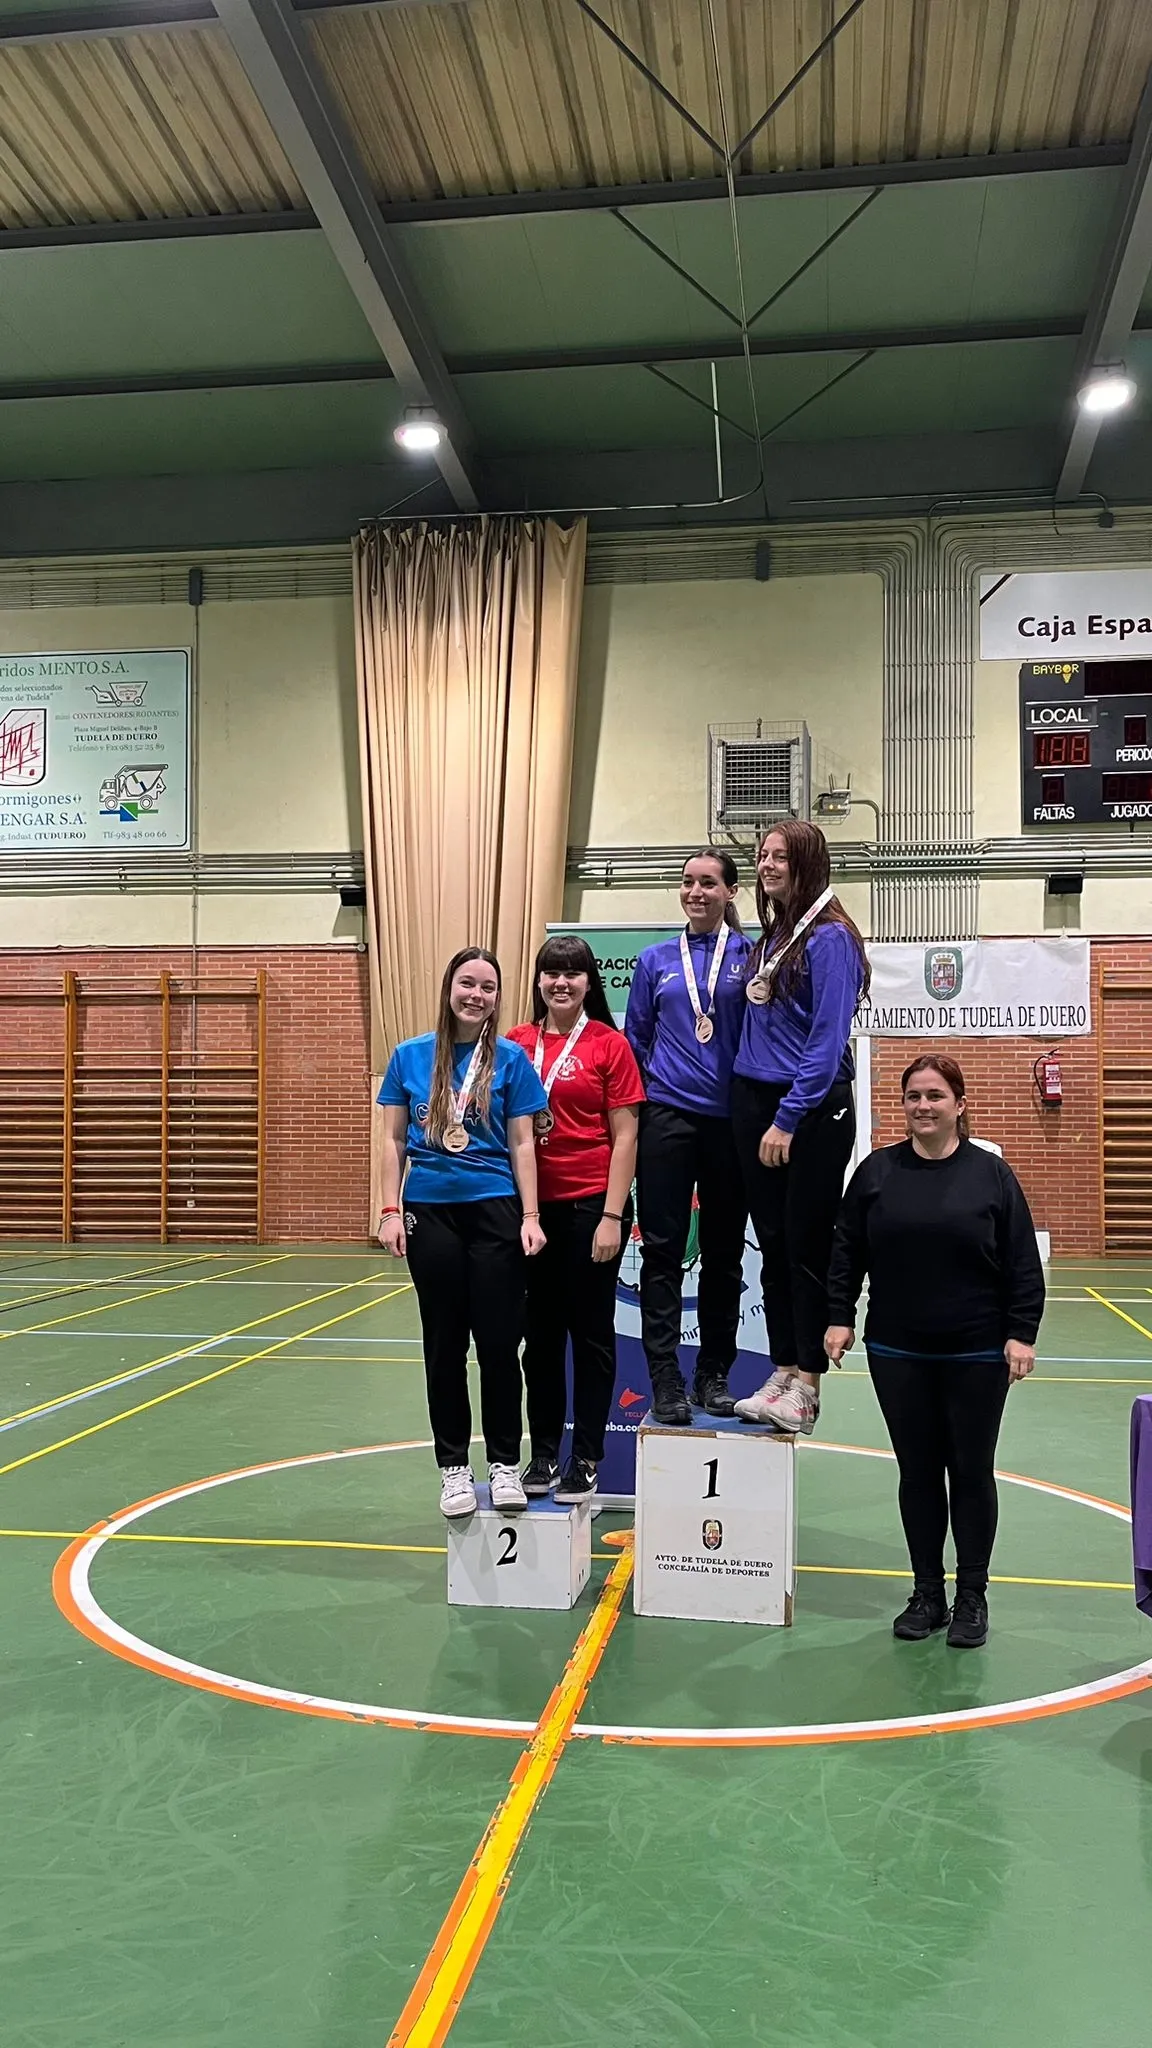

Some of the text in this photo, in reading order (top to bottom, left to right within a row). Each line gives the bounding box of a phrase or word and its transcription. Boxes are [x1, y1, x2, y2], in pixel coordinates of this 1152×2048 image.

[1018, 615, 1076, 643] Caja
[1031, 707, 1089, 724] LOCAL
[75, 734, 110, 742] TUDELA
[126, 733, 158, 741] DUERO
[0, 812, 87, 826] ENGAR S.A.
[1033, 806, 1075, 820] FALTAS
[853, 1005, 1087, 1028] NTAMIENTO DE TUDELA DE DUERO
[702, 1457, 721, 1499] 1
[496, 1526, 518, 1566] 2
[655, 1554, 679, 1563] AYTO.
[695, 1557, 728, 1566] TUDELA
[730, 1559, 742, 1567] DE
[744, 1560, 774, 1569] DUERO
[658, 1563, 710, 1573] CONCEJALÍA
[725, 1568, 770, 1577] DEPORTES
